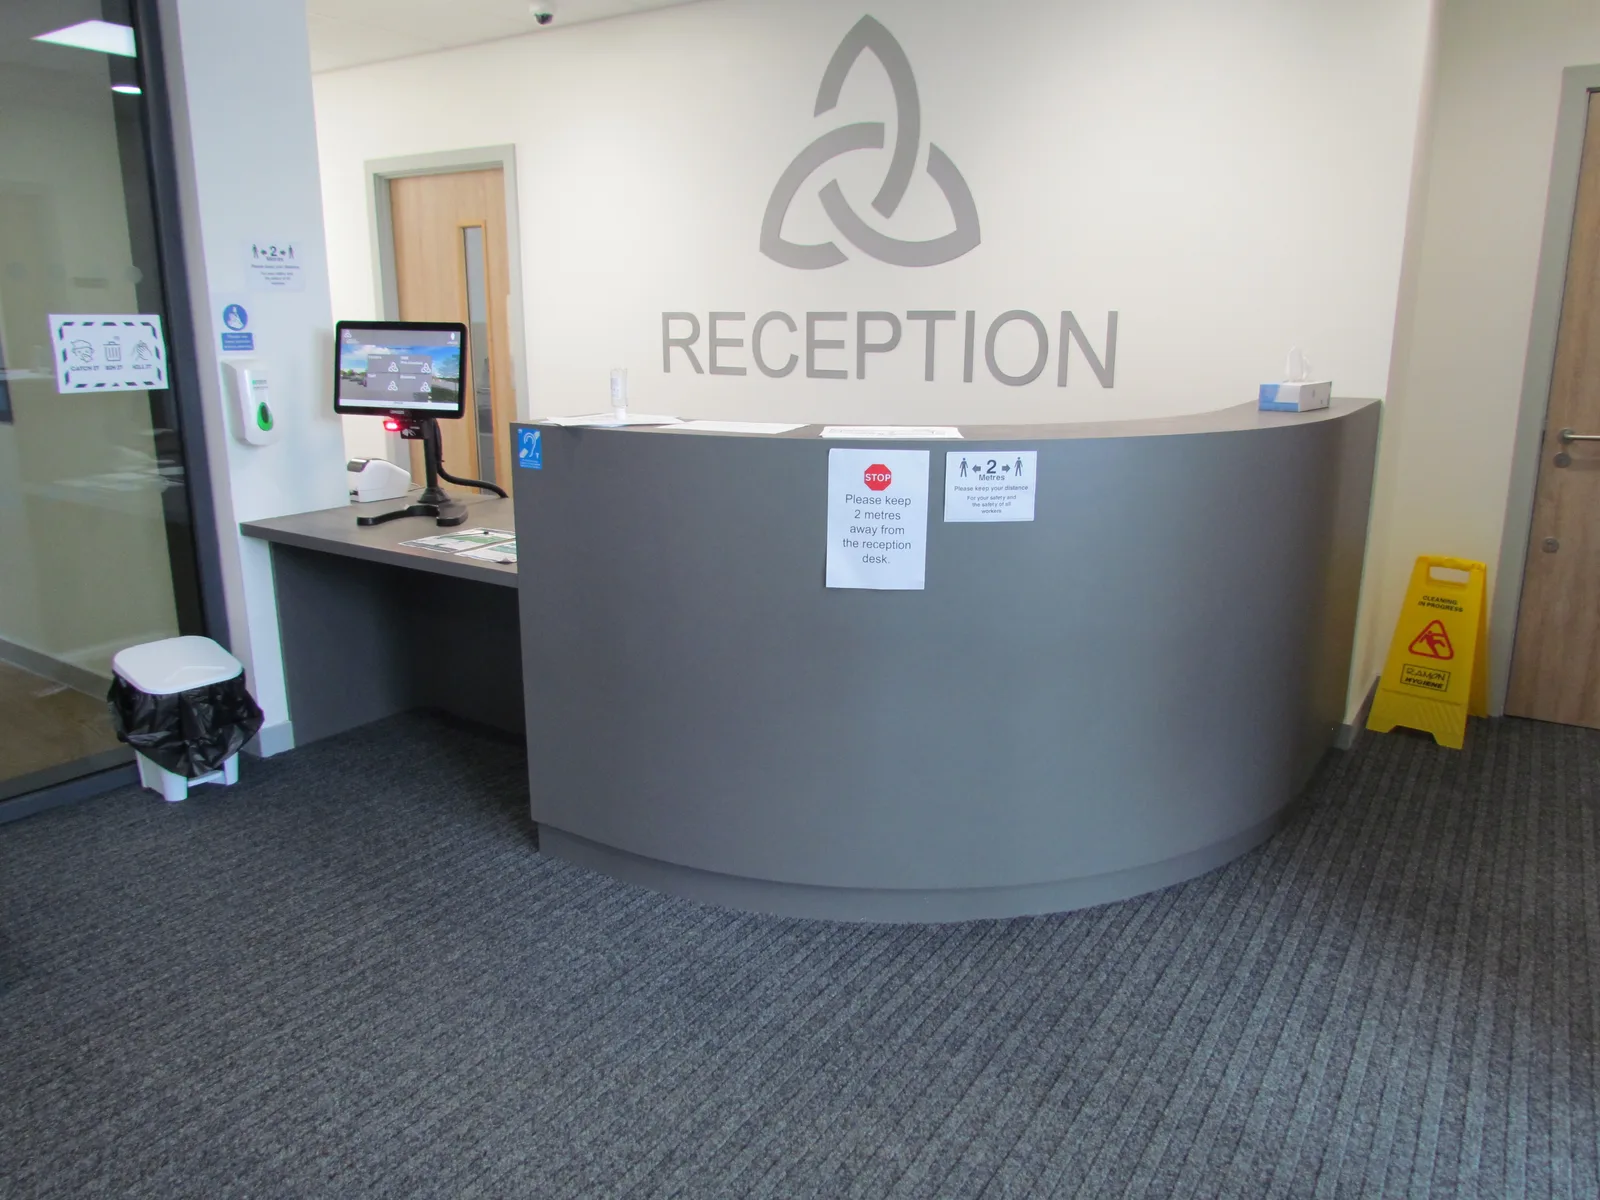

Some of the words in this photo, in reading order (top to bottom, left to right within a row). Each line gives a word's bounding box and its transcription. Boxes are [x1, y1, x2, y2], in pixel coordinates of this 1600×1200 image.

[269, 245, 277, 257] 2
[661, 309, 1119, 388] RECEPTION
[986, 459, 997, 474] 2
[865, 473, 891, 482] STOP
[845, 494, 882, 505] Please
[885, 495, 911, 507] keep
[854, 509, 861, 519] 2
[864, 511, 901, 520] metres
[850, 525, 878, 536] away
[881, 525, 905, 535] from
[843, 538, 859, 548] the
[862, 540, 911, 551] reception
[862, 554, 890, 564] desk.
[1422, 595, 1458, 605] CLEANING
[1426, 602, 1463, 612] PROGRESS
[1405, 677, 1444, 689] HYGIENE
